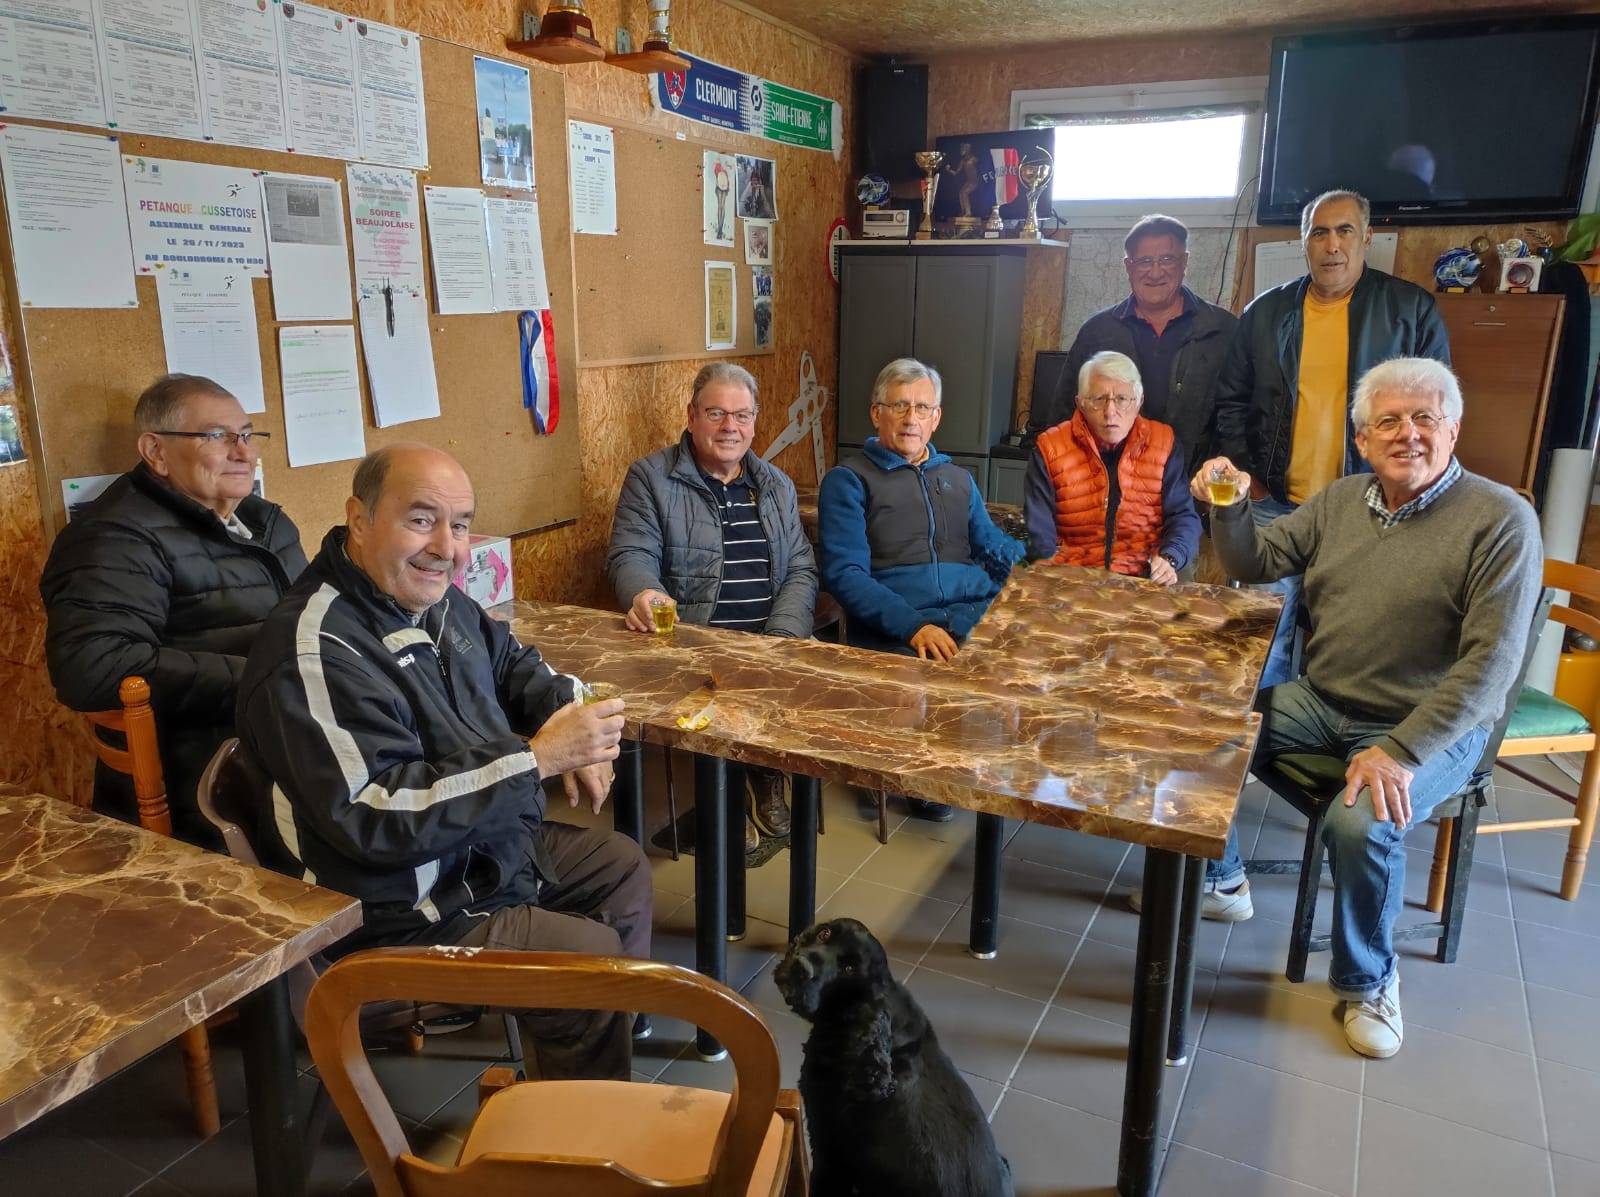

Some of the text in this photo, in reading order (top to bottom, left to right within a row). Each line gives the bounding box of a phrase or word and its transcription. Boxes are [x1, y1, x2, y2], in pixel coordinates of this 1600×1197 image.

[696, 78, 738, 111] CLERMONT
[140, 199, 257, 219] PETANQUE CUSSETOISE
[369, 208, 401, 218] SOIREE
[149, 220, 252, 233] ASSEMBLEE GENERALE
[355, 217, 416, 230] BEAUJOLAISE
[166, 238, 177, 246] LE
